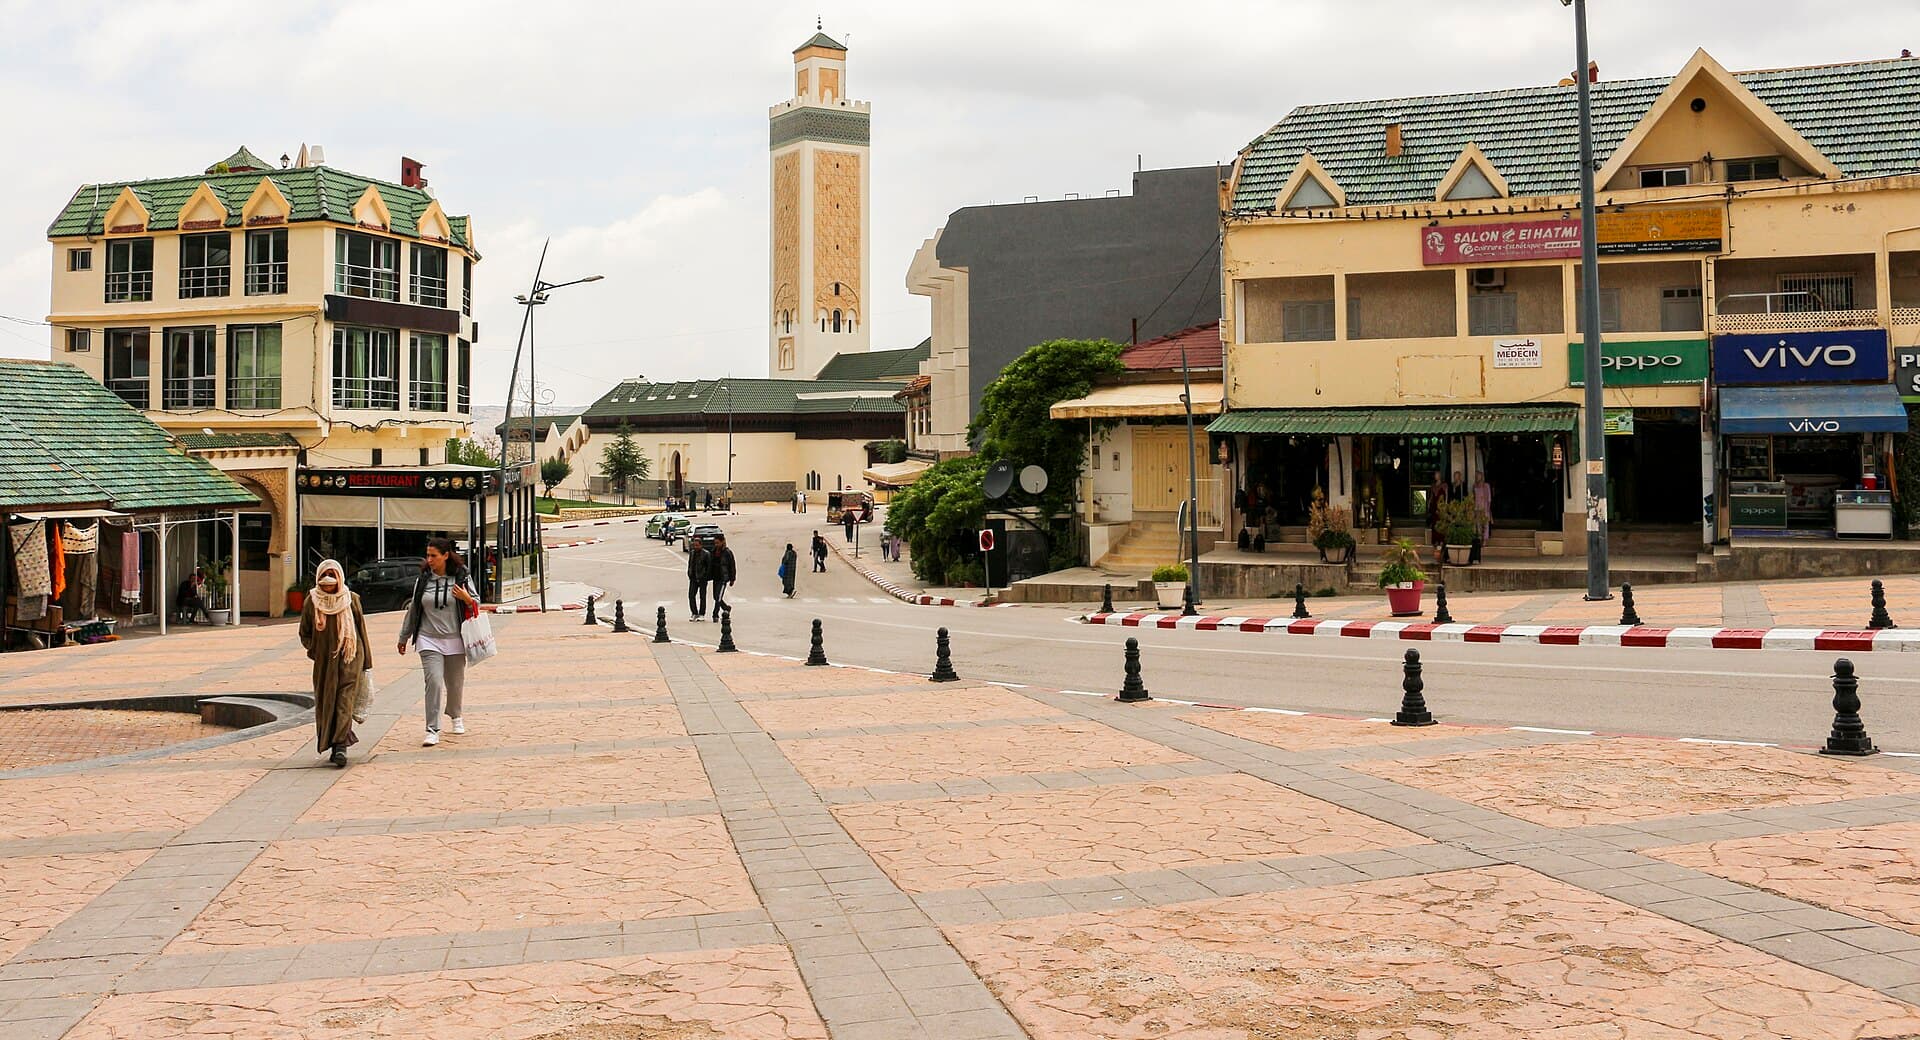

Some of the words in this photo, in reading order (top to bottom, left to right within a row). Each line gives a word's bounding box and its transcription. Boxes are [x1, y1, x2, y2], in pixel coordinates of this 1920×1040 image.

[1453, 230, 1499, 244] SALON
[1533, 226, 1579, 239] HATMI
[1500, 339, 1535, 350] طبيب
[1497, 350, 1538, 358] MEDECIN
[1743, 339, 1857, 368] vivo
[1789, 418, 1840, 432] vivo
[349, 474, 420, 487] RESTAURANT
